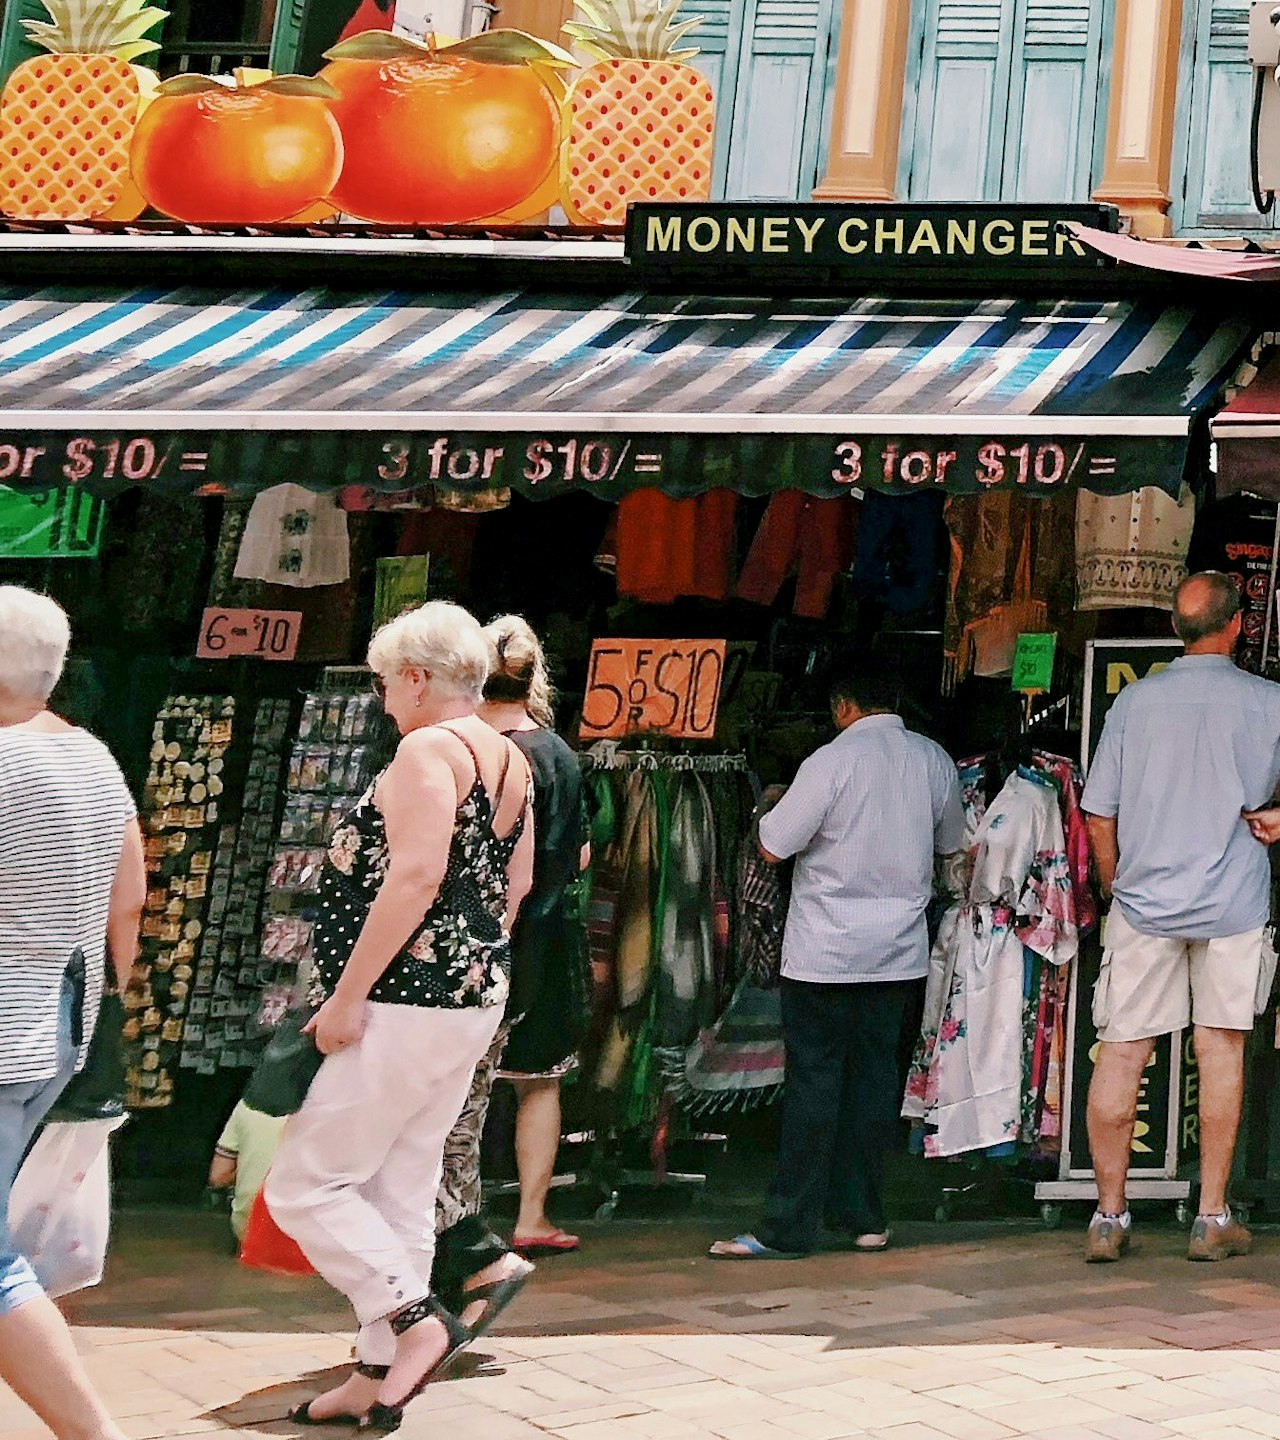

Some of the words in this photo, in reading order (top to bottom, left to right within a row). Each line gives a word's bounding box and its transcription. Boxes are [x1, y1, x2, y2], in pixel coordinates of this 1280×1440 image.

[644, 215, 825, 254] MONEY
[836, 218, 1087, 256] CHANGER
[0, 443, 46, 481] or
[377, 440, 410, 481] 3
[427, 437, 505, 480] for
[831, 441, 863, 484] 3
[880, 441, 957, 484] for
[206, 613, 229, 651] 6
[580, 648, 624, 731] 5
